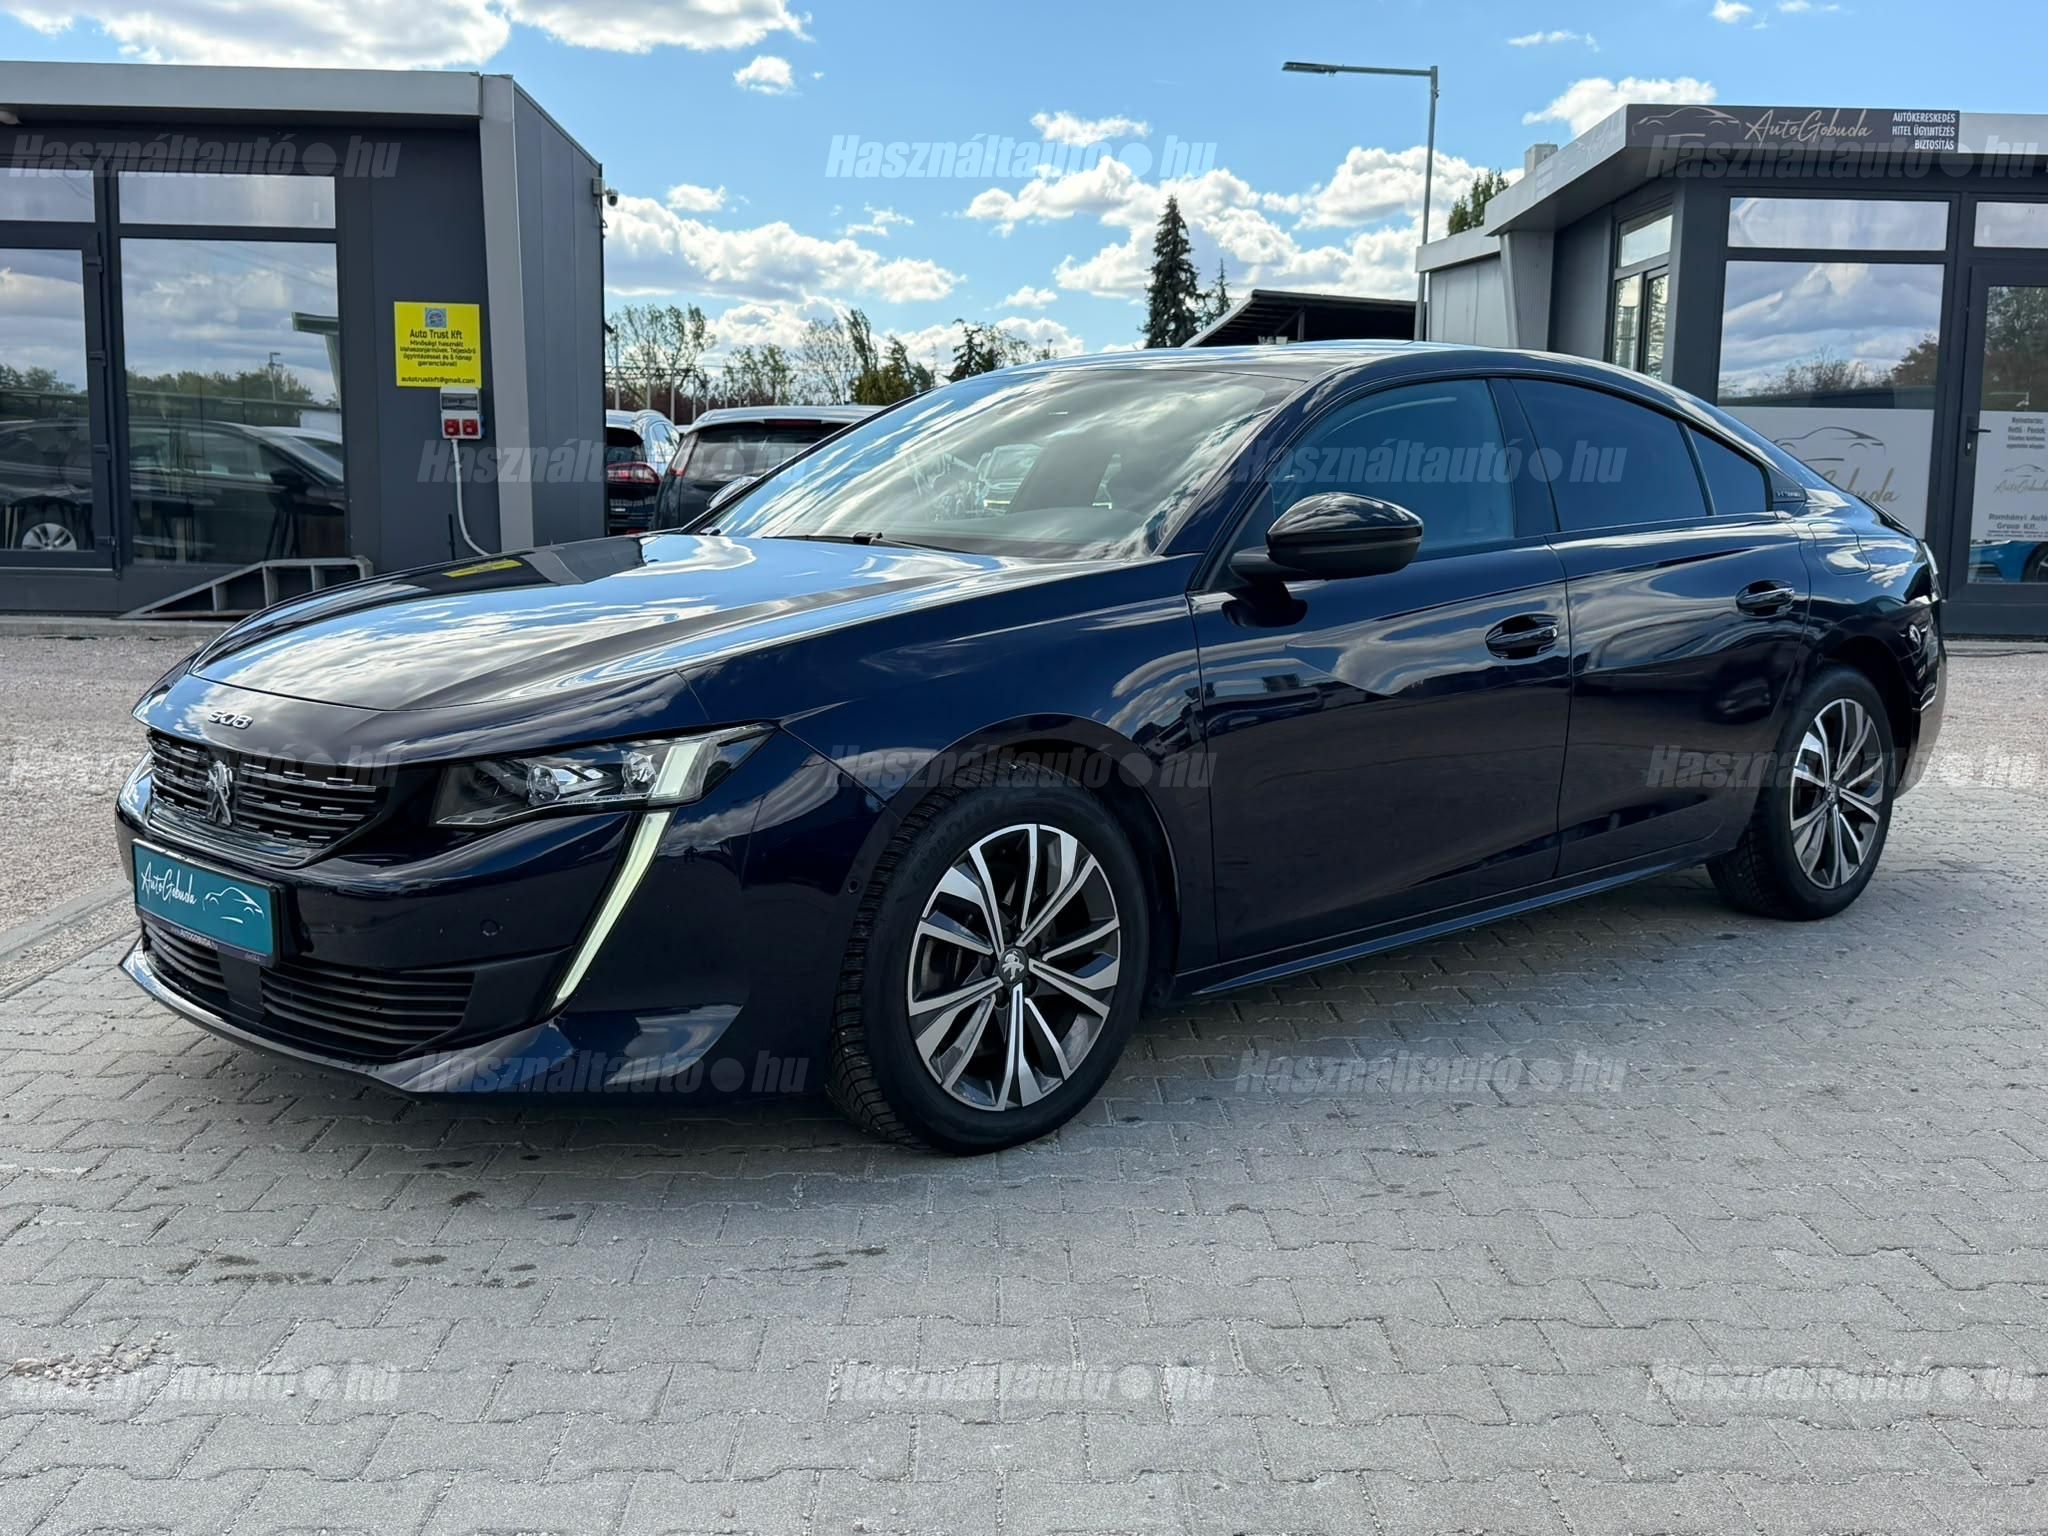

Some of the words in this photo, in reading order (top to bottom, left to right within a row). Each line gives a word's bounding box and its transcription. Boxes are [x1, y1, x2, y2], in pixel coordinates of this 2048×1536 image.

[1744, 108, 1873, 148] AutoGobuda
[1892, 125, 1912, 136] HITEL
[1913, 125, 1956, 137] ÜGYINTÉZÉS
[1914, 138, 1955, 150] BIZTOSÍTÁS
[410, 329, 428, 338] Auto
[429, 330, 449, 339] Trust
[451, 330, 463, 340] Kft
[208, 710, 253, 729] 508
[141, 861, 198, 905] AutoGobuda
